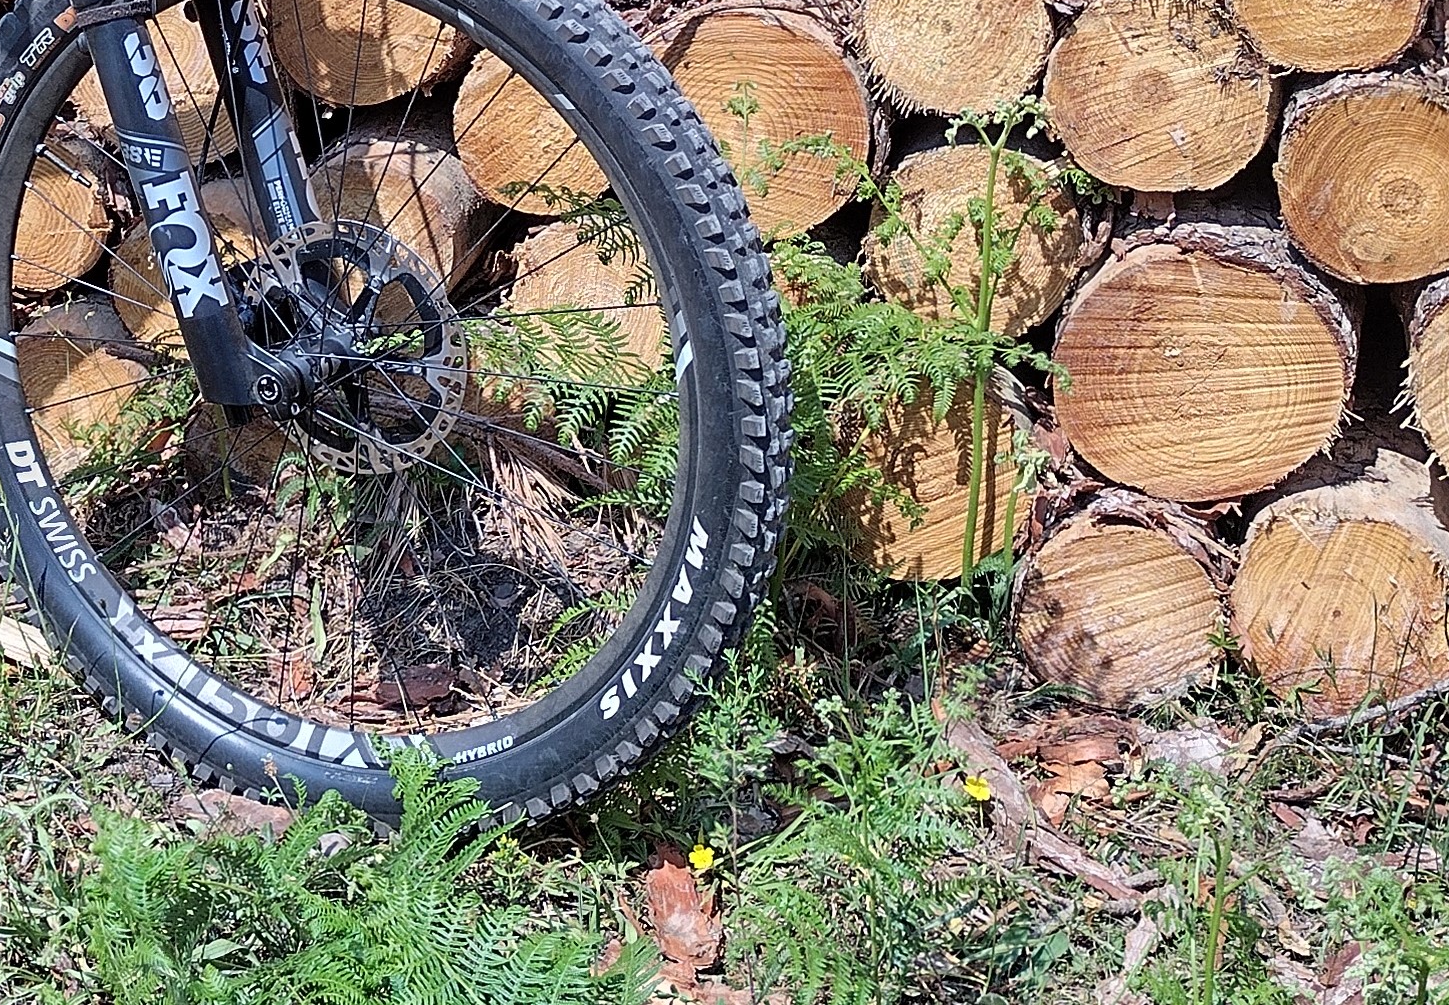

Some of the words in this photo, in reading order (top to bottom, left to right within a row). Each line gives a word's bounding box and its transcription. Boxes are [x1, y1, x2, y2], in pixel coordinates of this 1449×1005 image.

[19, 27, 55, 67] TR
[142, 170, 229, 318] FOX
[272, 201, 285, 224] ELITE
[5, 440, 48, 488] DT
[29, 496, 97, 583] SWISS
[600, 515, 709, 720] MAXXIS
[453, 735, 514, 764] HYBRID
